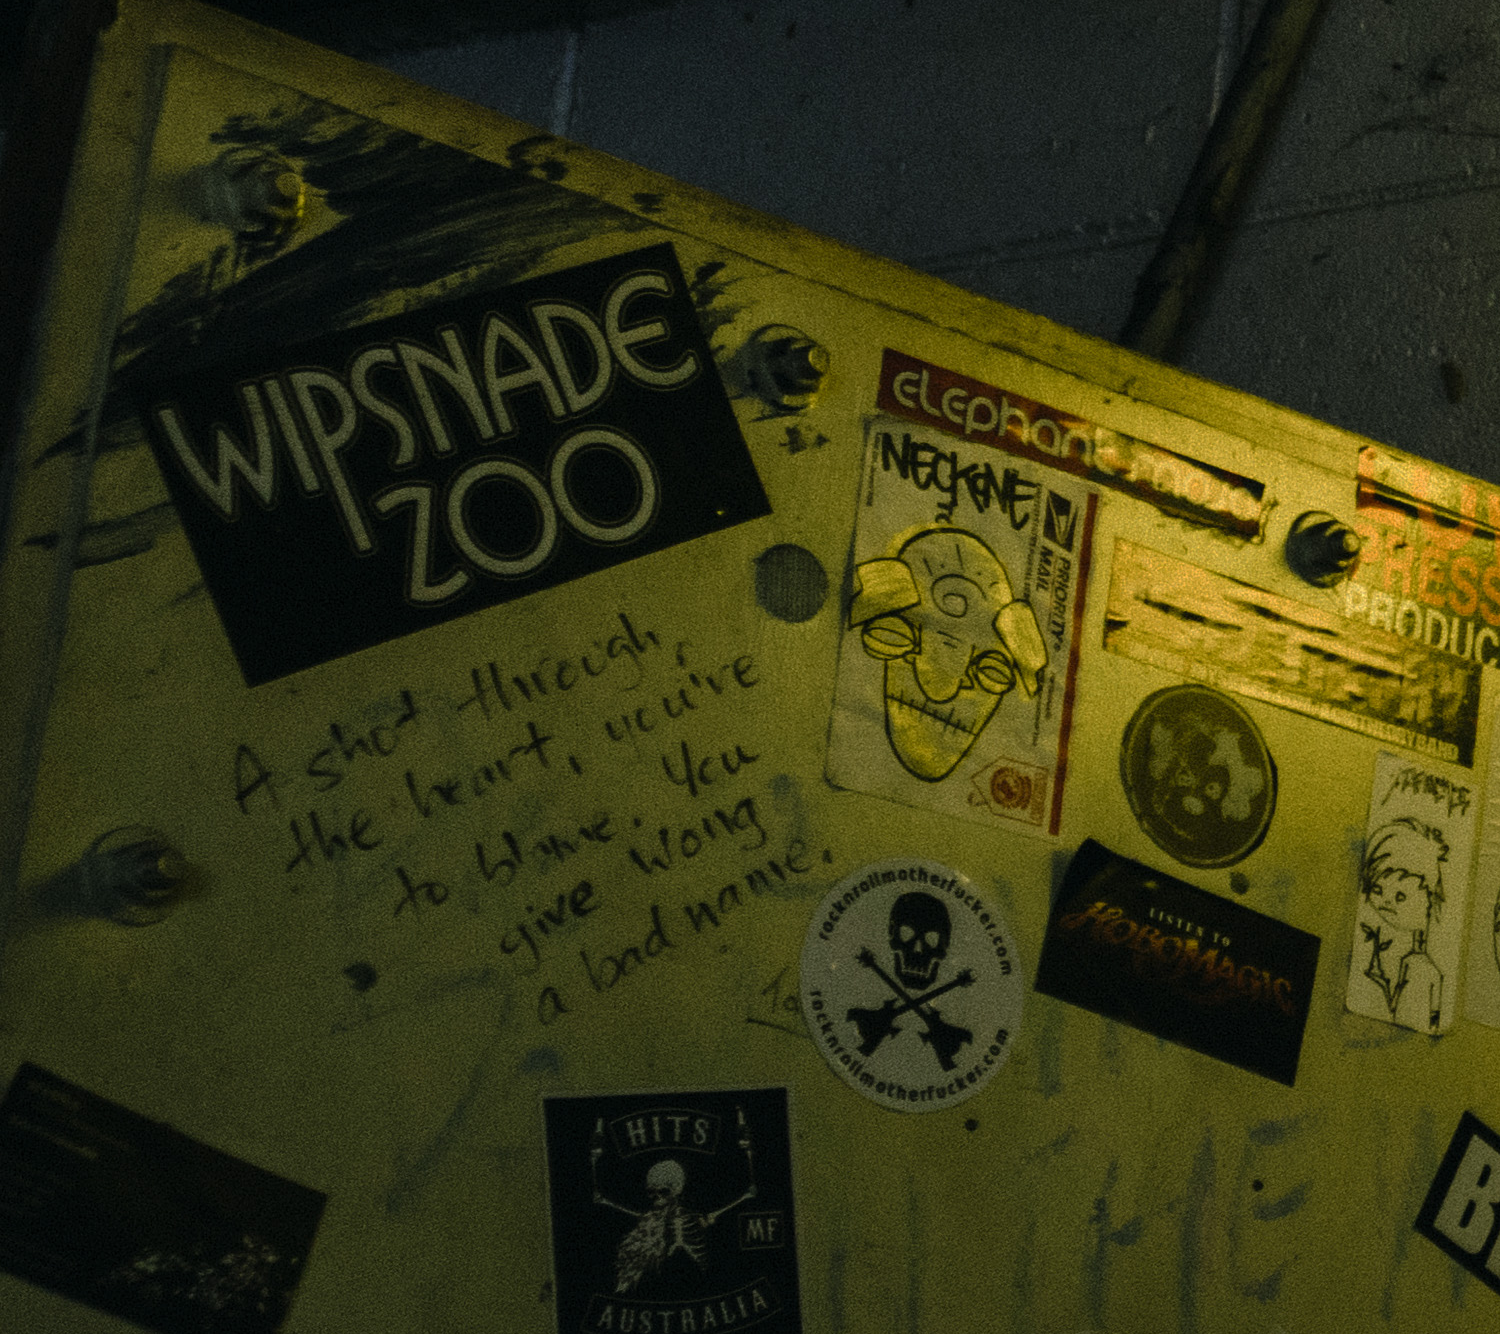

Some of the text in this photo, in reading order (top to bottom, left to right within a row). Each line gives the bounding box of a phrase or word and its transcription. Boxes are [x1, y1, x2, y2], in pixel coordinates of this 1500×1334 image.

[152, 270, 700, 557] WIPSNADE
[373, 425, 661, 607] ZOO
[307, 690, 418, 792] shot
[286, 801, 384, 876] the
[392, 864, 450, 921] to
[500, 880, 598, 959] give
[816, 865, 1013, 978] rocknrollmotherfucker.com
[1147, 906, 1233, 948] LISTEN TO
[537, 985, 569, 1026] a
[580, 905, 674, 992] bad
[808, 987, 1011, 1104] rocknrollmotherfucker.com
[623, 1112, 711, 1148] HITS
[745, 1215, 780, 1245] MF
